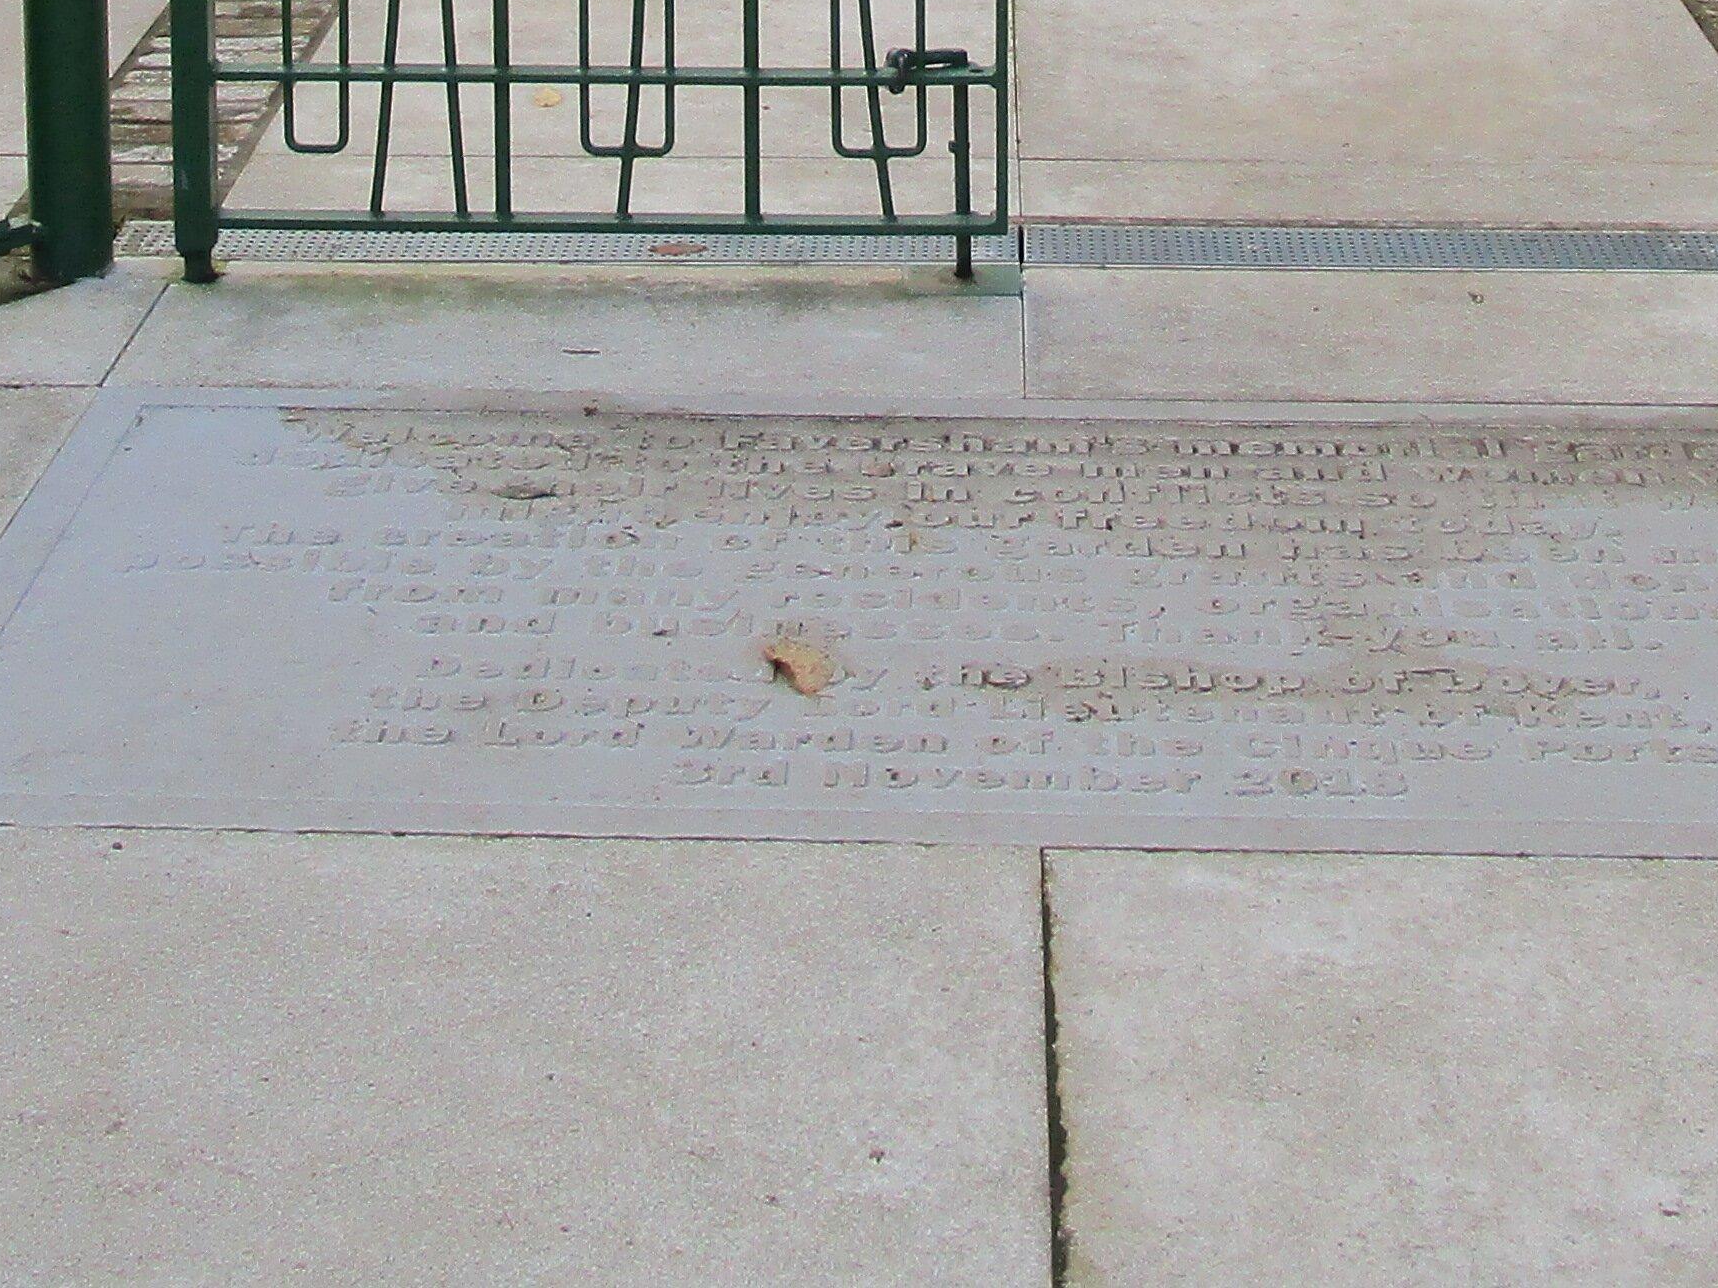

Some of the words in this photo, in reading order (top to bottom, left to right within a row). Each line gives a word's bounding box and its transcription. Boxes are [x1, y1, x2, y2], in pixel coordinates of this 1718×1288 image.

[719, 453, 831, 476] the
[859, 455, 1052, 479] brave
[1078, 459, 1230, 481] men
[1256, 461, 1388, 483] and
[708, 478, 877, 501] lives
[905, 480, 971, 504] in
[1056, 508, 1366, 535] freedom
[221, 522, 342, 546] The
[820, 531, 958, 555] this
[993, 535, 1248, 560] garden
[470, 552, 555, 581] by
[584, 554, 703, 579] the
[733, 560, 1088, 584] generous
[327, 578, 505, 603] from
[538, 587, 741, 611] many
[413, 611, 556, 635] and
[1058, 665, 1306, 696] Bishop
[368, 687, 488, 712] the
[511, 689, 771, 722] Deputy
[329, 719, 455, 745] the
[482, 720, 644, 748] Lord
[680, 725, 948, 753] Warden
[977, 730, 1055, 755] of
[1086, 732, 1203, 758] the
[1233, 733, 1493, 765] Cinque
[667, 759, 789, 788] 3rd
[821, 763, 1201, 794] November
